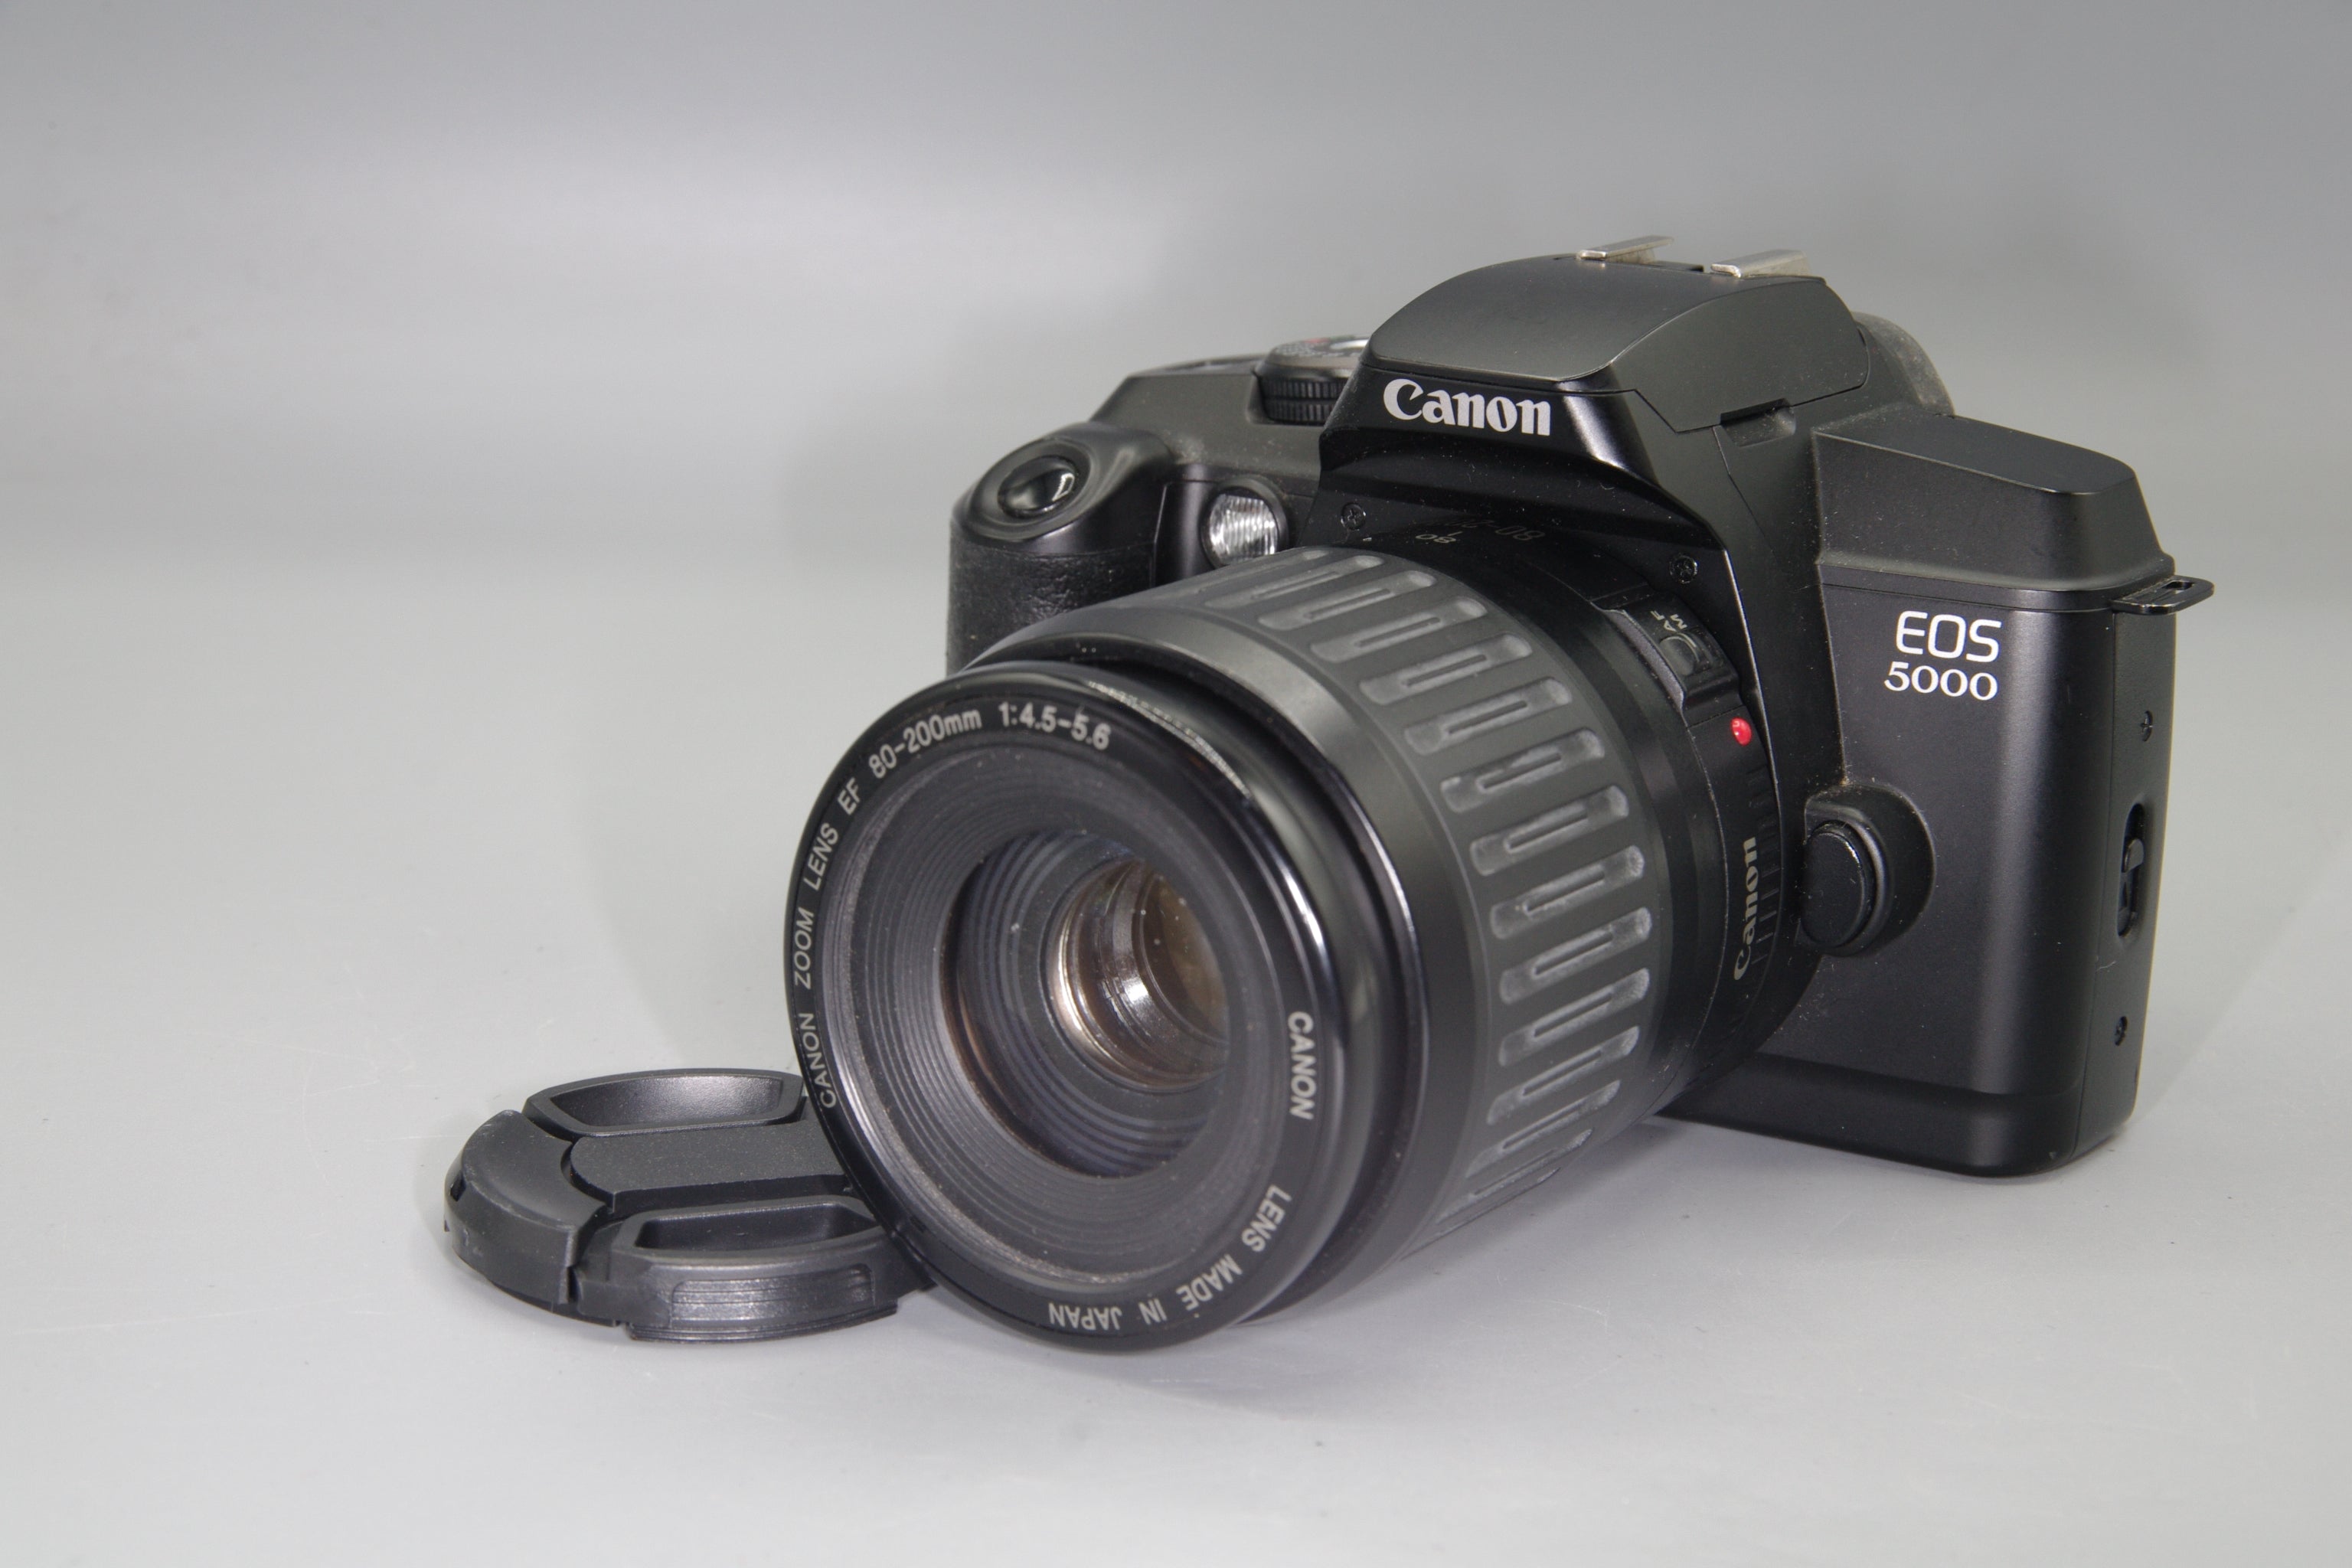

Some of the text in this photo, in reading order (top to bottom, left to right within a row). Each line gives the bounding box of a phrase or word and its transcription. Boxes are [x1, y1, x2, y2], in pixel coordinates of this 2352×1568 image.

[1383, 378, 1551, 436] Canon
[1650, 610, 1677, 632] AF
[1670, 613, 1687, 629] M
[1895, 610, 2002, 662] EOS
[1884, 662, 1998, 701] 5000
[792, 701, 1111, 1109] CANON ZOOM LENS EF 80-200mm 1:4.5-5.6
[1733, 836, 1757, 980] Canon
[1048, 1010, 1317, 1331] CANON LENS MADE IN JAPAN
